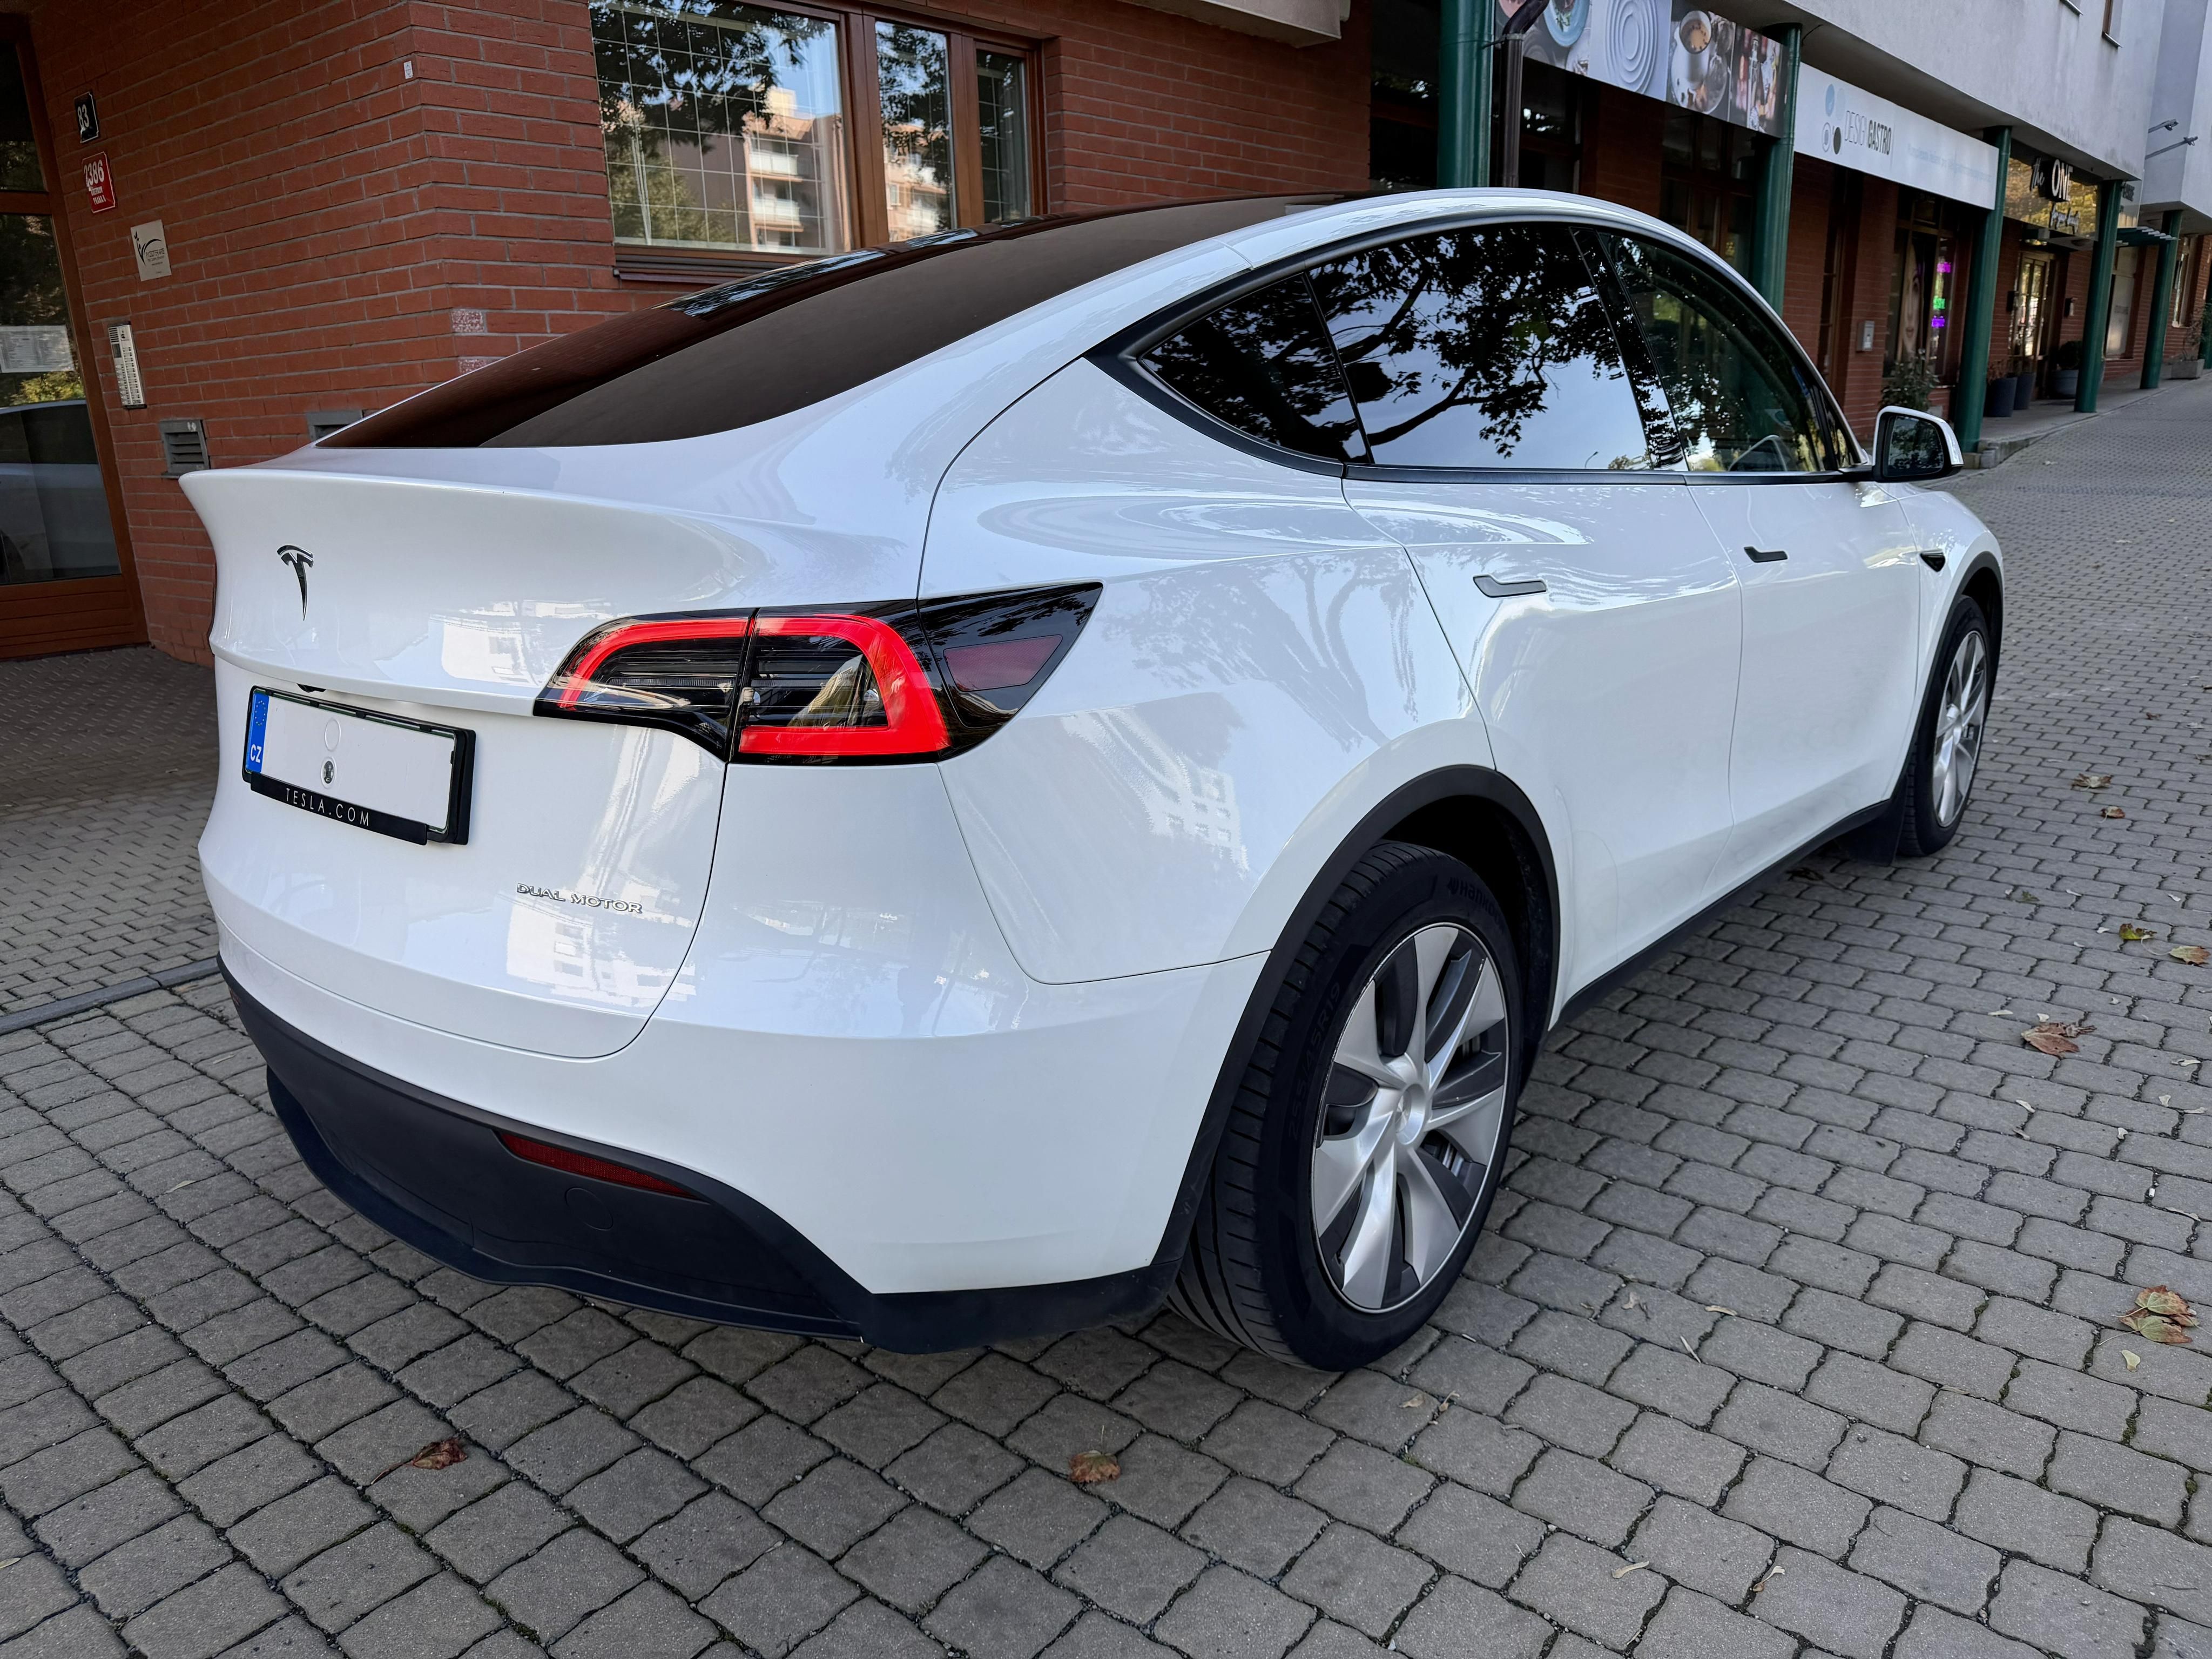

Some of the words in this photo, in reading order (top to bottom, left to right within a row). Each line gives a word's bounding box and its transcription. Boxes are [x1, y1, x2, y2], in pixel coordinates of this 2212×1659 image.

[77, 104, 90, 128] 83
[1869, 119, 1892, 155] GASTRO
[84, 160, 104, 187] 2386
[2052, 159, 2073, 201] ONE
[250, 744, 262, 763] CZ
[286, 787, 369, 827] TESLA.COM
[517, 883, 566, 902] DUAL
[570, 893, 643, 914] MOTOR
